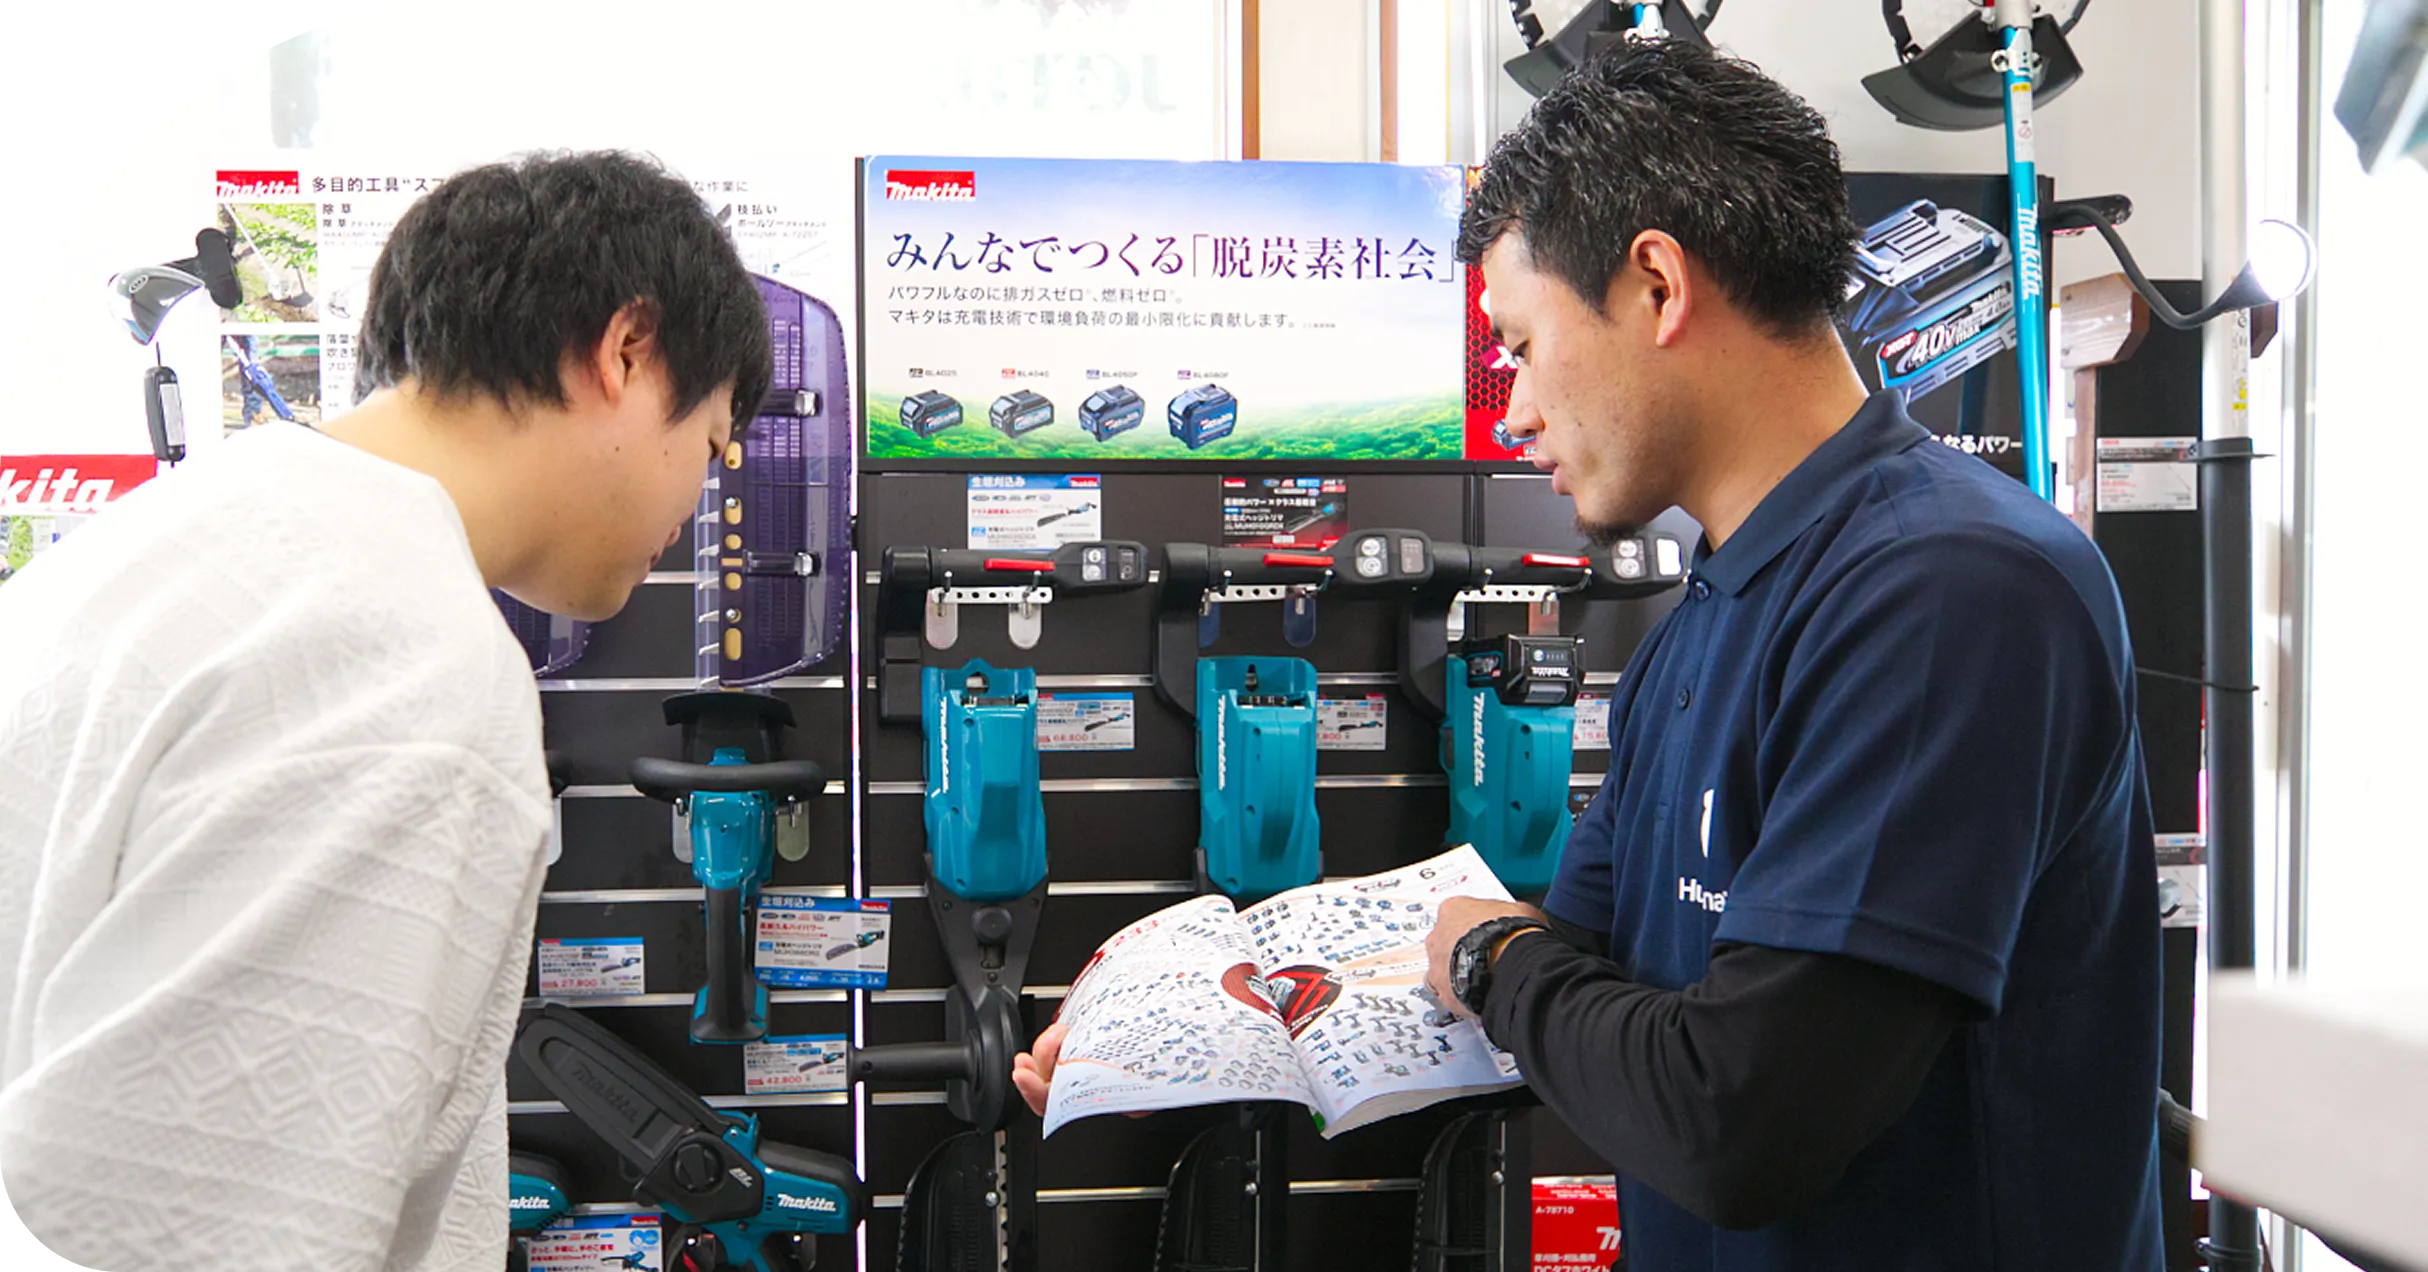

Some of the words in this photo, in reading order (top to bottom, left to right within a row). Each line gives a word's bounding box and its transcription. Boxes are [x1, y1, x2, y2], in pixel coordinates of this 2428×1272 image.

[737, 204, 777, 216] 枝払い
[886, 231, 1455, 284] みんなでつくる「脱炭素社会」
[889, 308, 1295, 330] マキタは充電技術で環境負荷の最小限化に貢献します。
